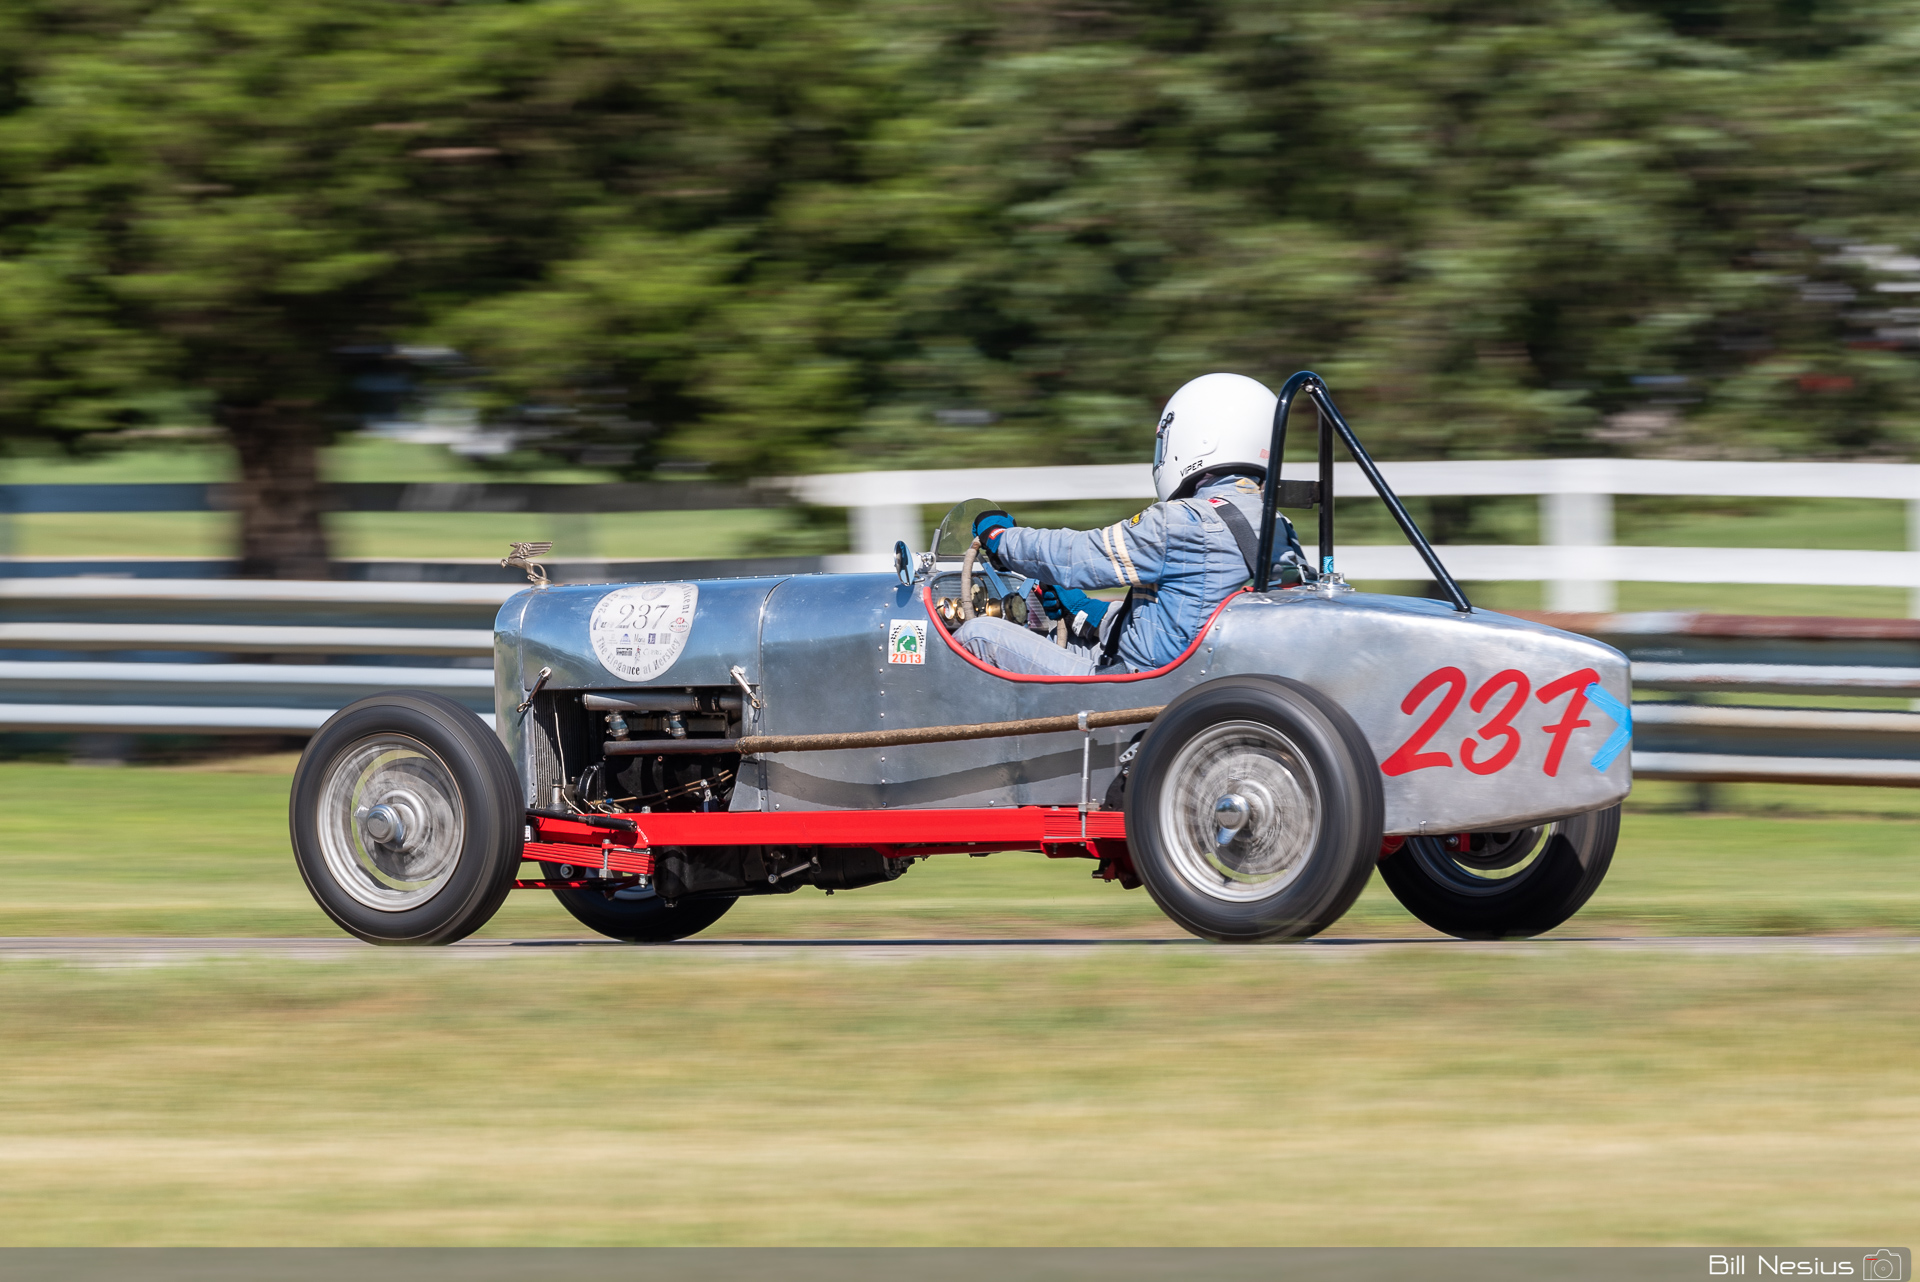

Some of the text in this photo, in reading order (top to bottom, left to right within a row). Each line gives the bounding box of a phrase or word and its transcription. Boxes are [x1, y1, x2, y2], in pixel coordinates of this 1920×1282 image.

[1180, 459, 1203, 477] VIPER
[616, 604, 670, 629] 237
[596, 635, 608, 655] The
[606, 652, 640, 676] Elegance
[643, 664, 651, 675] at
[652, 637, 681, 671] Hershey
[892, 653, 922, 664] 2013
[1380, 666, 1601, 777] 237
